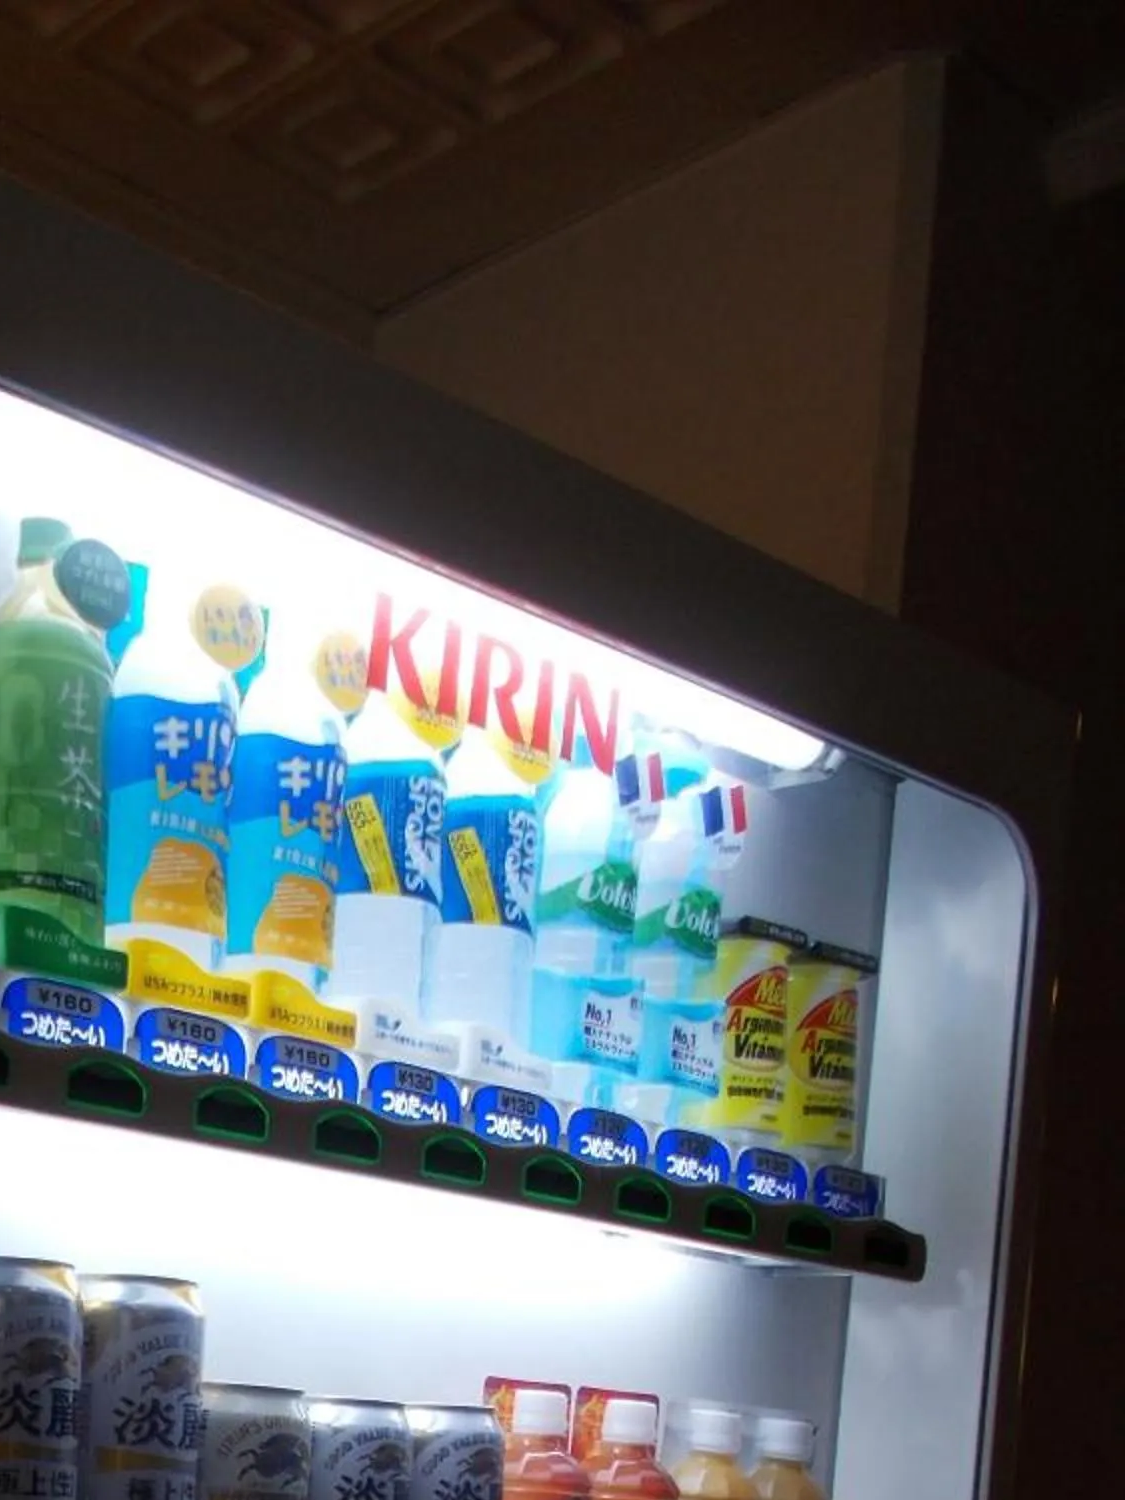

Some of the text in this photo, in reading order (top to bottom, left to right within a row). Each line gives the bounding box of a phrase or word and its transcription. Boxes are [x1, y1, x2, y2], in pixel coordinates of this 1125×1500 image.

[366, 590, 621, 778] KIRIN
[58, 674, 104, 812] 生茶
[38, 986, 93, 1013] ¥160
[21, 1011, 106, 1048] つめた～い
[152, 1039, 230, 1075] つめた～い
[272, 1066, 344, 1100] つめた～い
